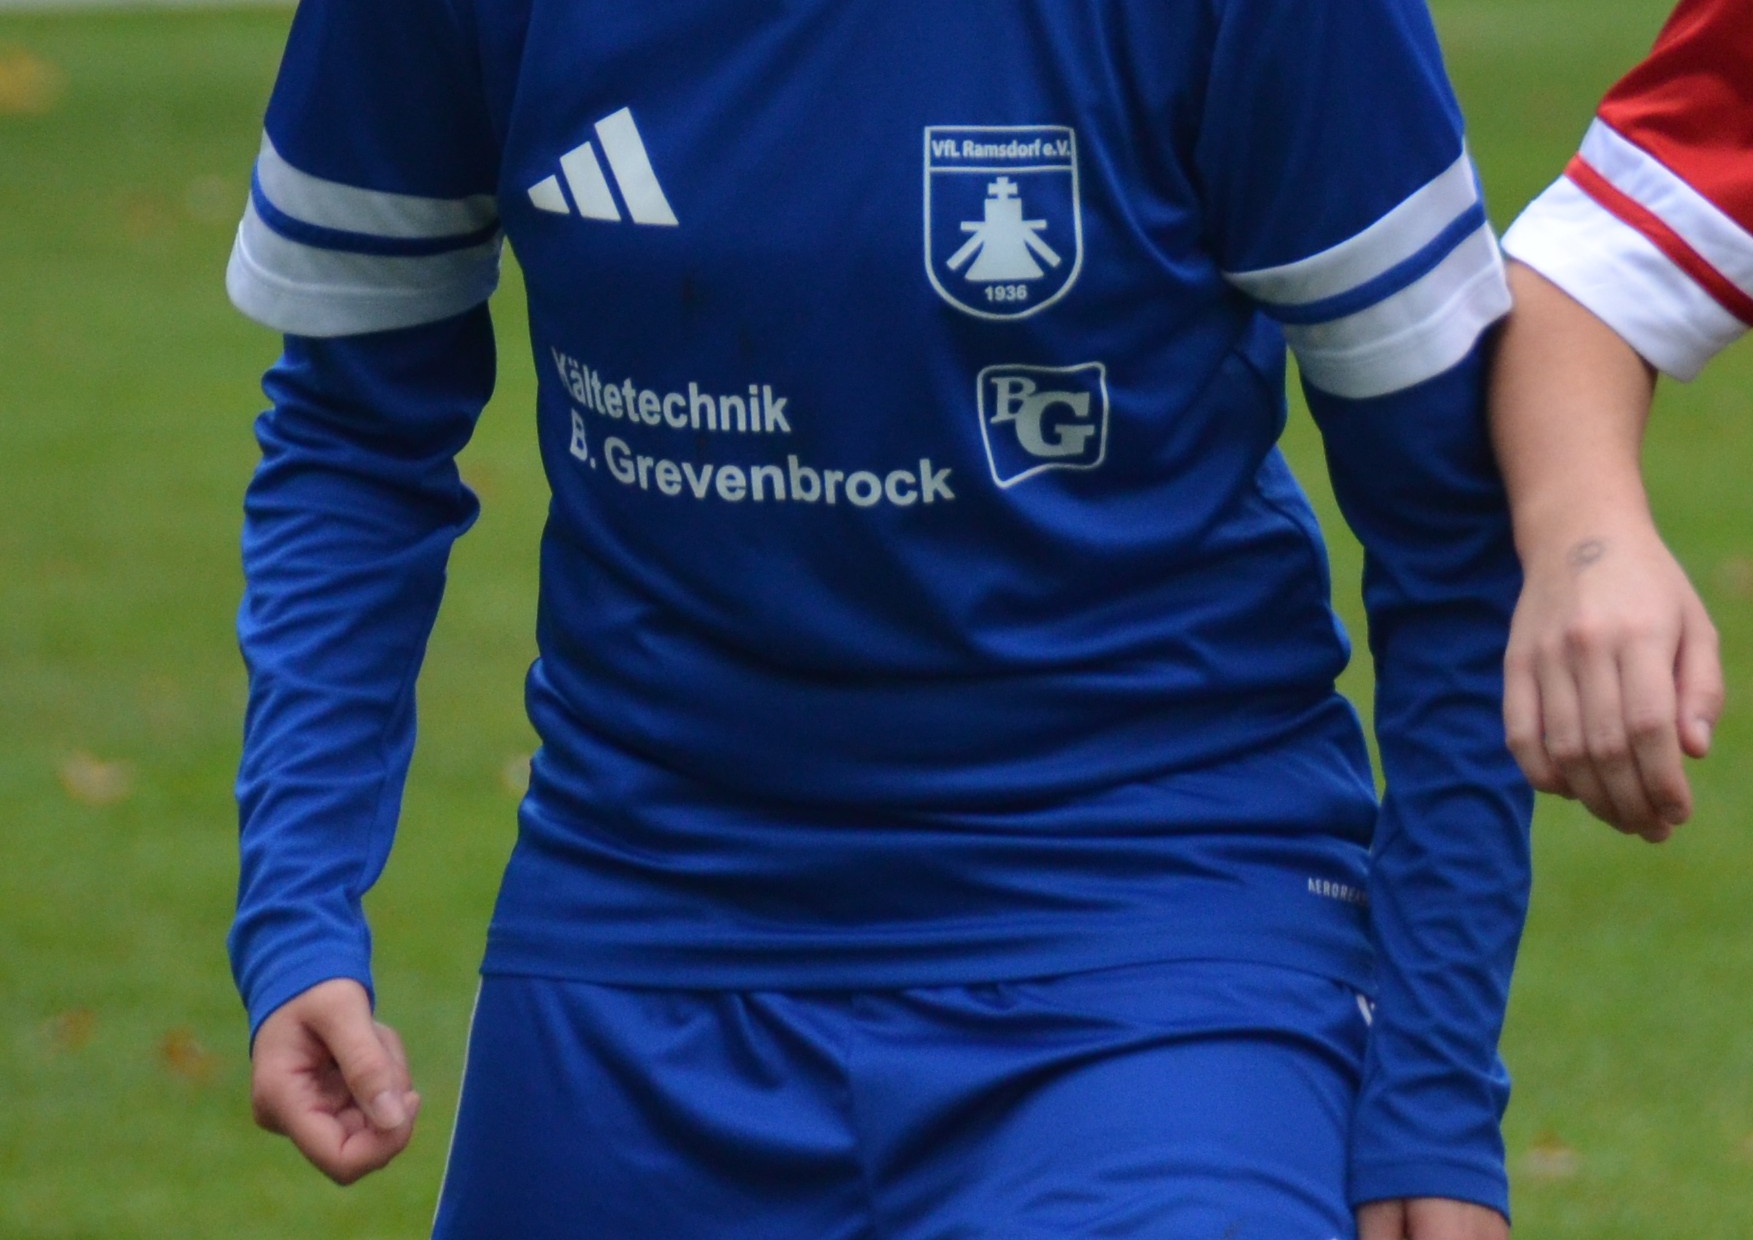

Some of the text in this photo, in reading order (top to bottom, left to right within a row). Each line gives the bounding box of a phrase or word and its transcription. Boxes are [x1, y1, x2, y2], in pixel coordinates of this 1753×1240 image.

[931, 138, 1071, 158] VfL Ramsdorf e.V.
[984, 284, 1028, 302] 1936
[550, 345, 792, 434] Kältetechnik
[569, 408, 956, 507] B. Grevenbrock
